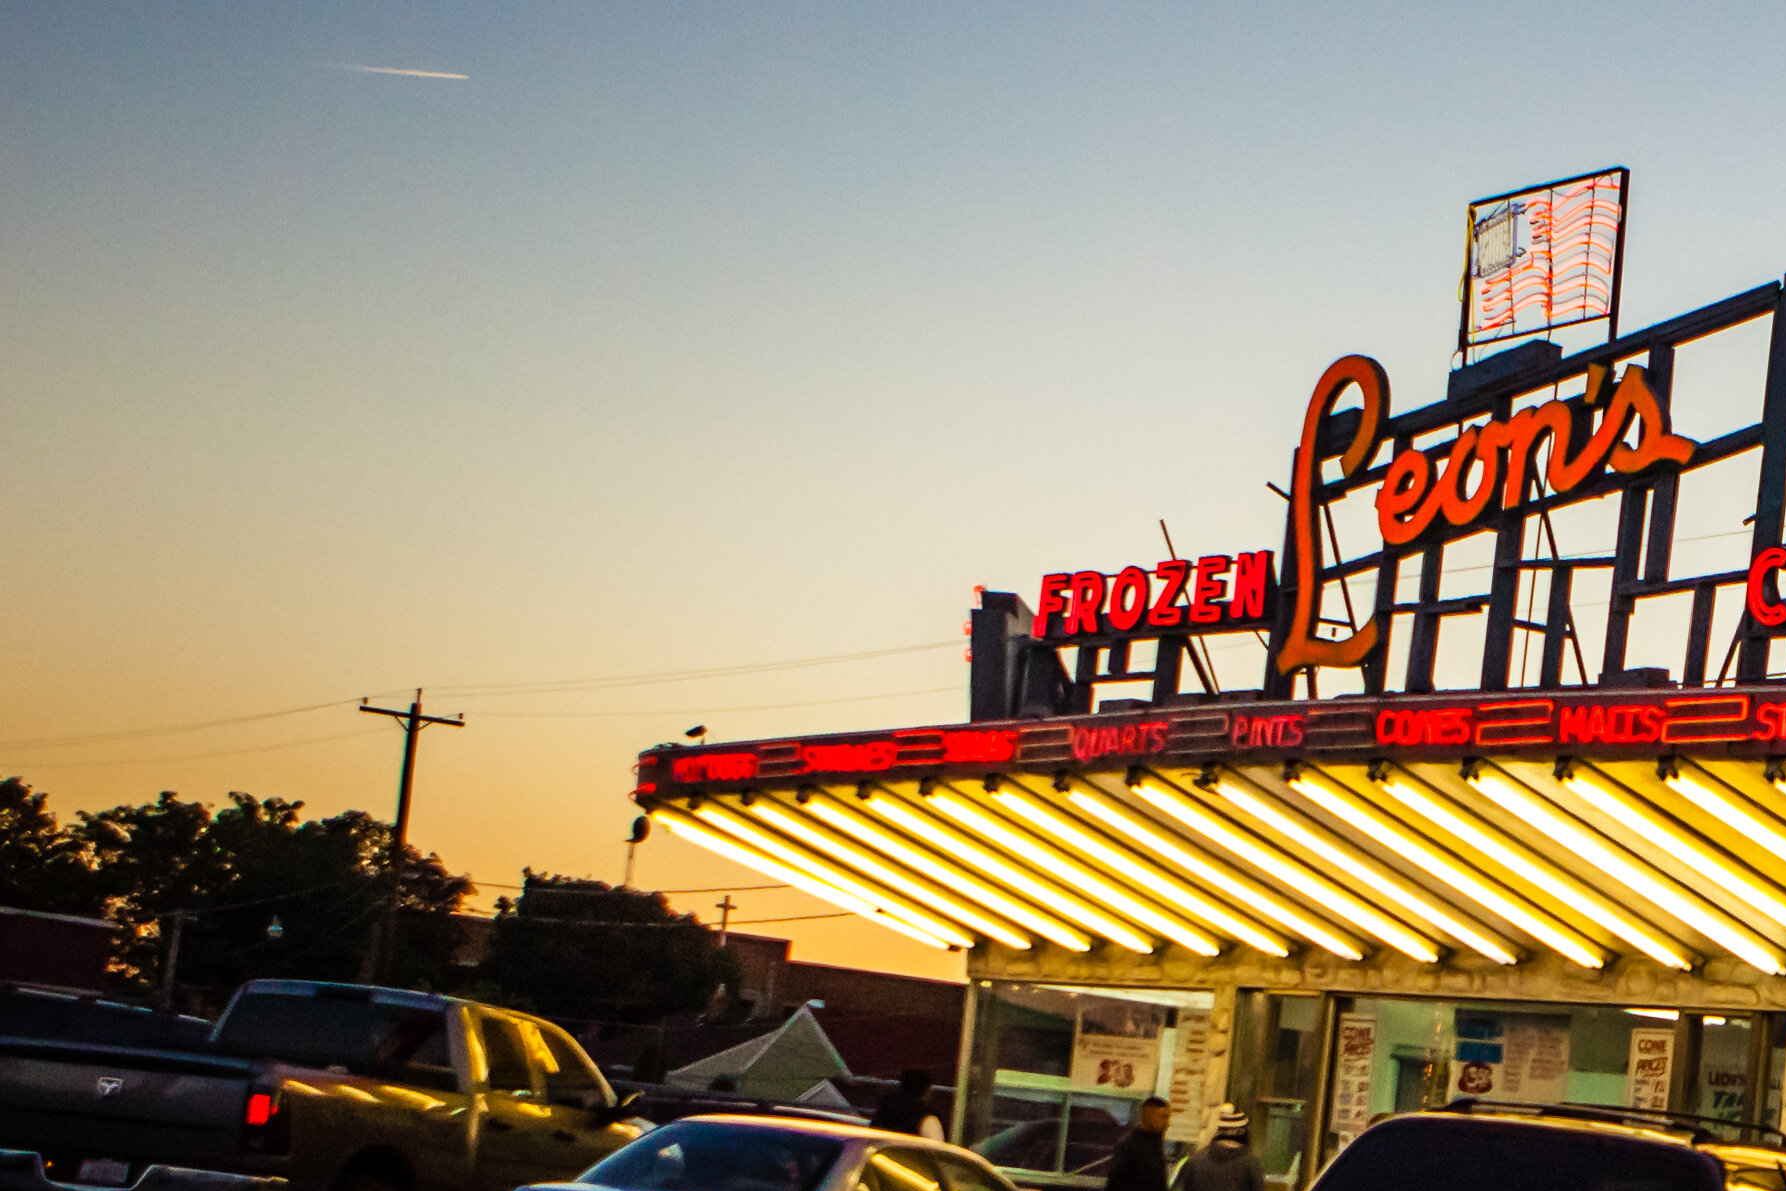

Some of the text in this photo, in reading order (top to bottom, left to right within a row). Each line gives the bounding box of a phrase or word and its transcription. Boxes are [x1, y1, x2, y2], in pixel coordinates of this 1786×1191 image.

[1278, 354, 1697, 674] Leon's
[1033, 549, 1275, 638] FROZEN
[1230, 715, 1304, 748] PINTS
[1376, 707, 1473, 745] CONES
[1559, 704, 1664, 745] MALTS
